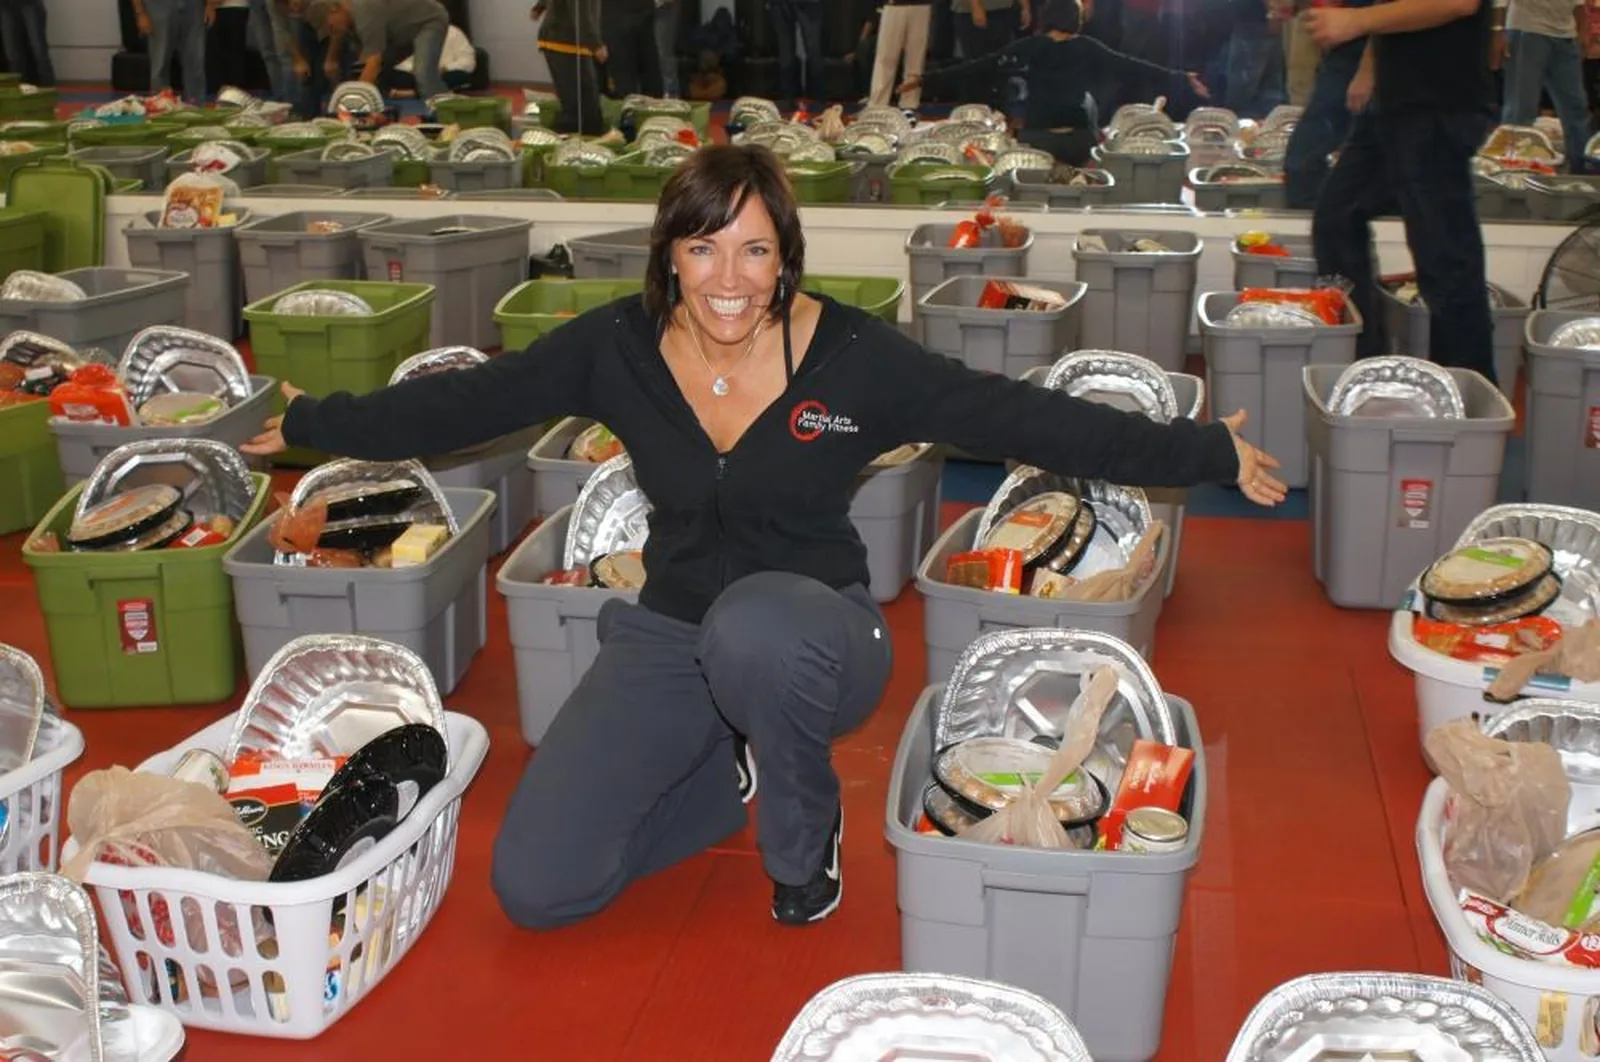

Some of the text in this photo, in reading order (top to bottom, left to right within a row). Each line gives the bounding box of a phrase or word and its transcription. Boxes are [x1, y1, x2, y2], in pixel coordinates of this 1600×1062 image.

[797, 417, 859, 433] Family Fitness
[802, 410, 852, 425] Martial Arts
